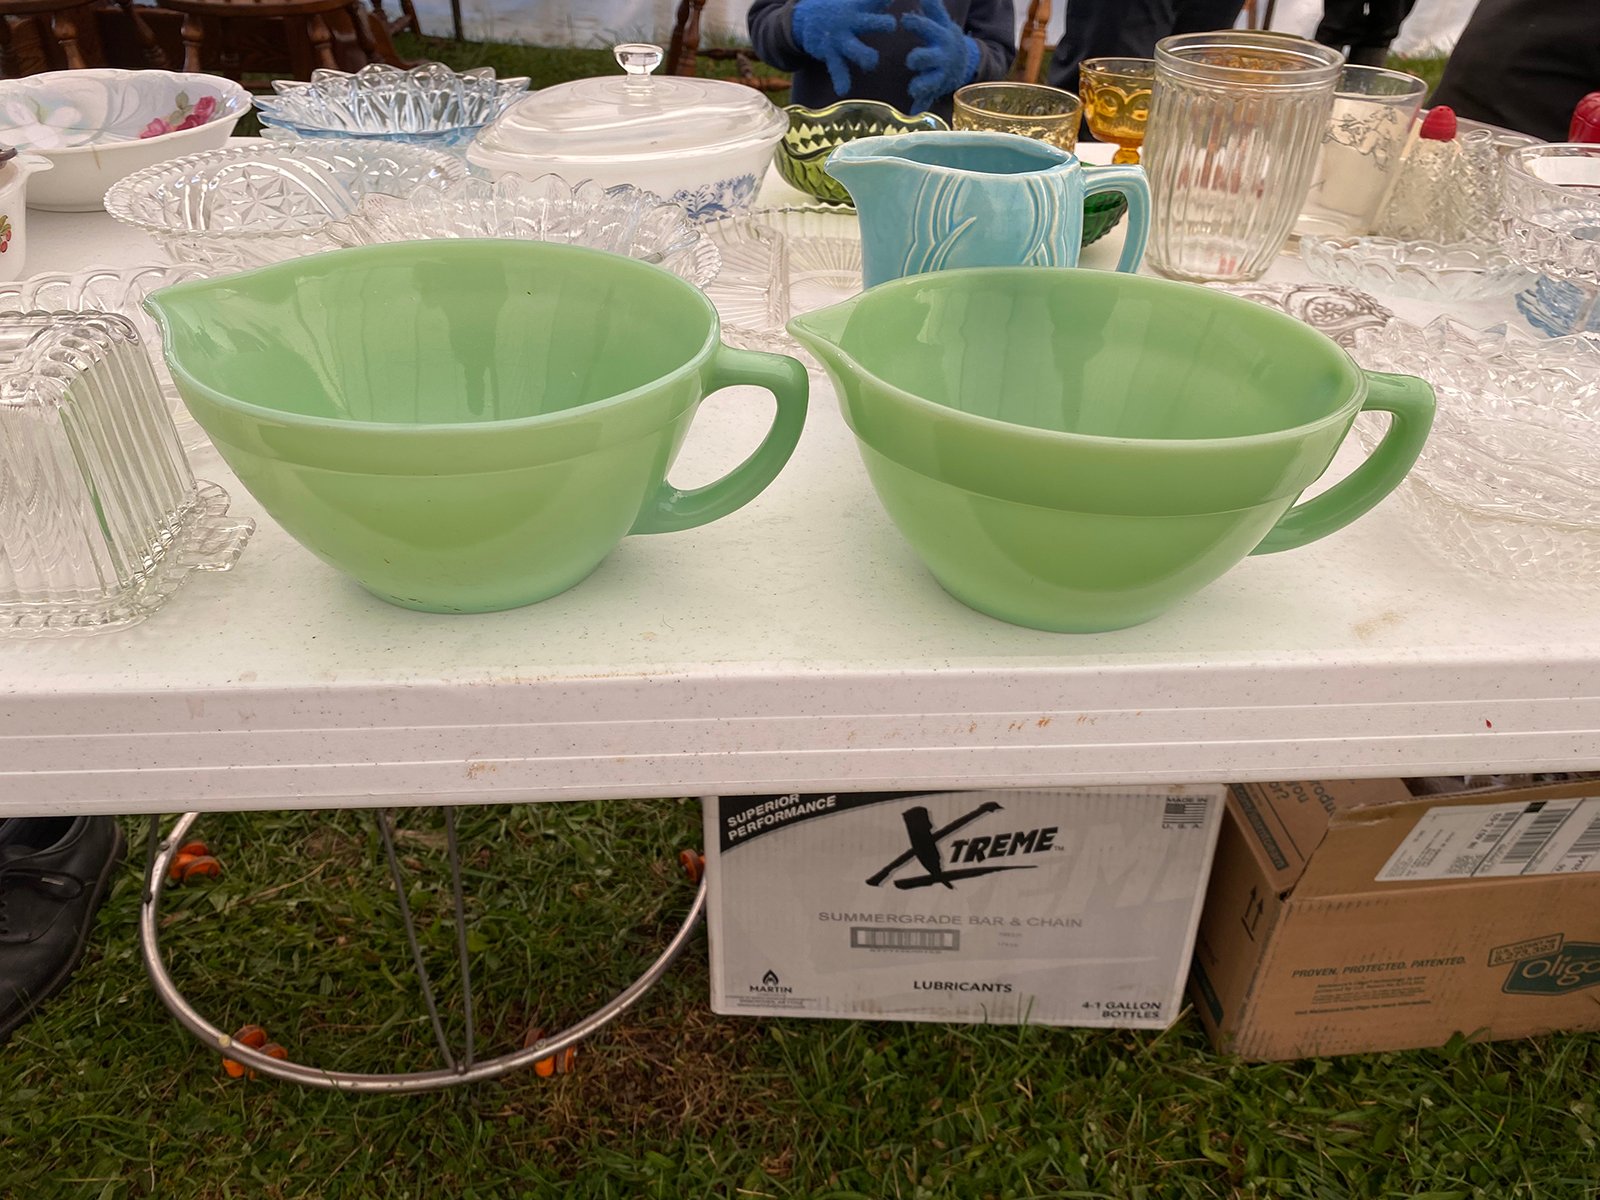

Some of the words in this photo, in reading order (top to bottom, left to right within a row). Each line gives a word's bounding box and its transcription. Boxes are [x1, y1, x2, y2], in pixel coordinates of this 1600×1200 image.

[727, 793, 800, 827] SUPERIOR
[728, 795, 837, 840] PERFORMANCE
[865, 801, 1059, 890] XTREME
[818, 912, 962, 925] SUMMERGRADE
[968, 916, 1004, 926] BAR
[1009, 916, 1021, 926] &
[1026, 917, 1083, 928] CHAIN
[1291, 968, 1339, 978] PROVEN.
[1342, 961, 1407, 974] PROTECTED.
[1410, 956, 1467, 969] PATENTED.
[1522, 954, 1600, 986] Oligo
[749, 985, 792, 993] MARTIN
[913, 980, 1012, 993] LUBRICANTS
[1081, 1001, 1100, 1009] 4-1
[1105, 1001, 1161, 1009] GALLON
[1102, 1010, 1159, 1018] BOTTLES
